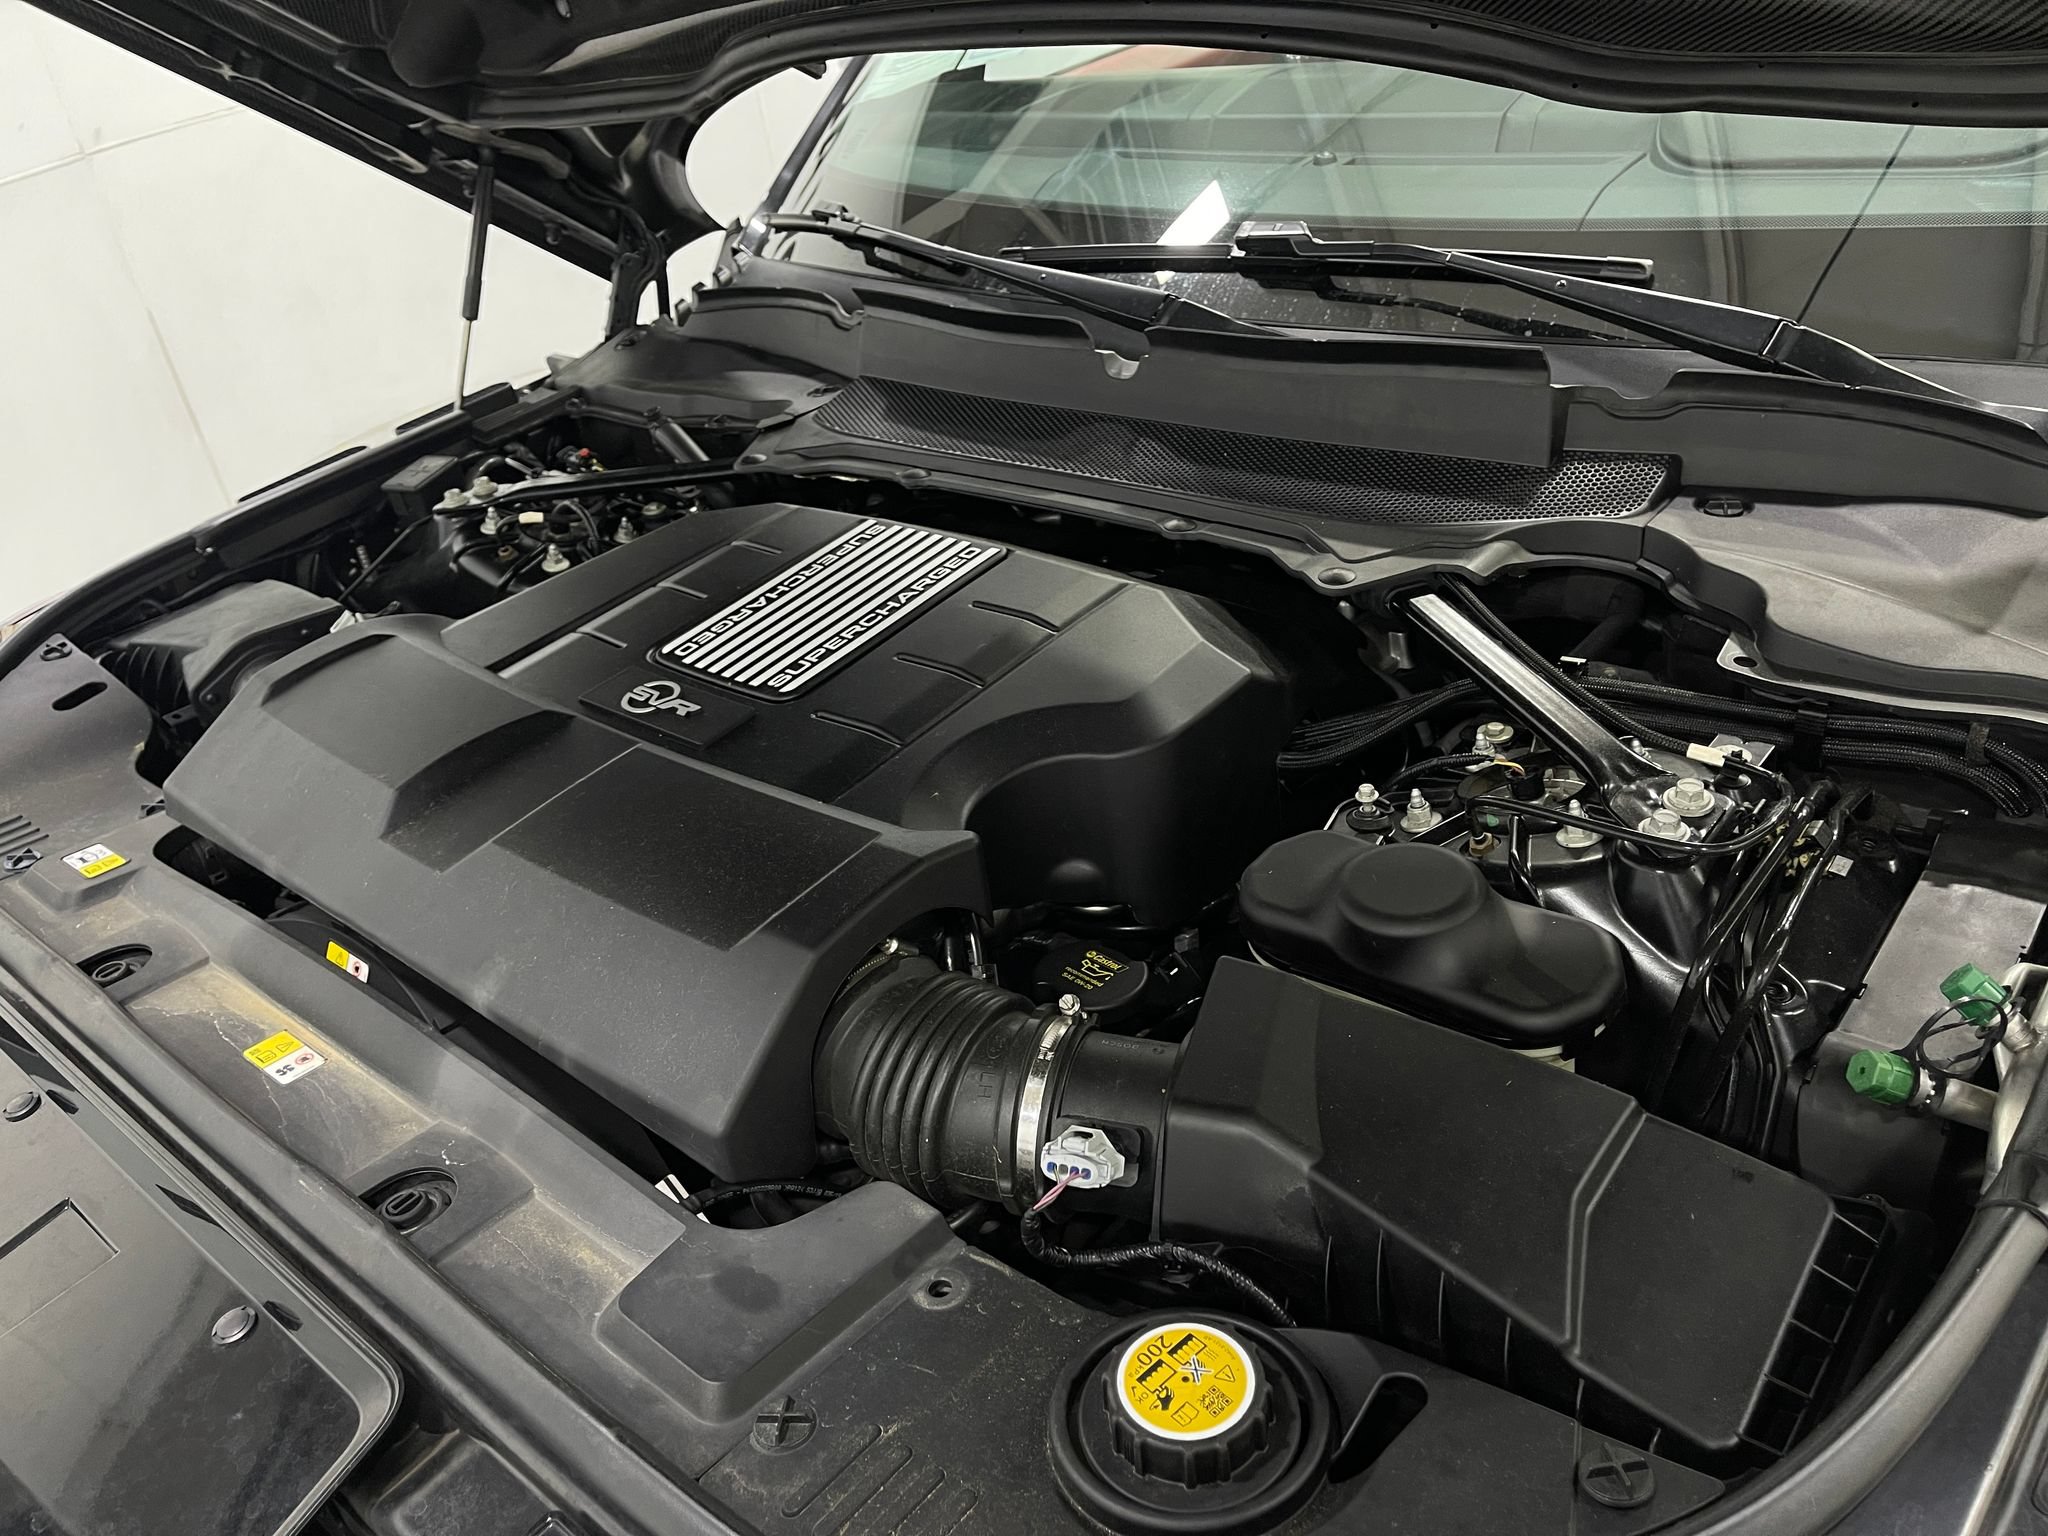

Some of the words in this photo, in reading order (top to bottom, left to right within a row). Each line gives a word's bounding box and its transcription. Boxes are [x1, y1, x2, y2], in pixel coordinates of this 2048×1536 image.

[674, 523, 887, 657] SUPERCHARGED
[767, 546, 982, 688] SUPERCHARGED
[626, 681, 701, 717] SVR
[1094, 955, 1122, 970] Castrol
[1137, 1335, 1173, 1366] 200
[1137, 1391, 1149, 1404] OK
